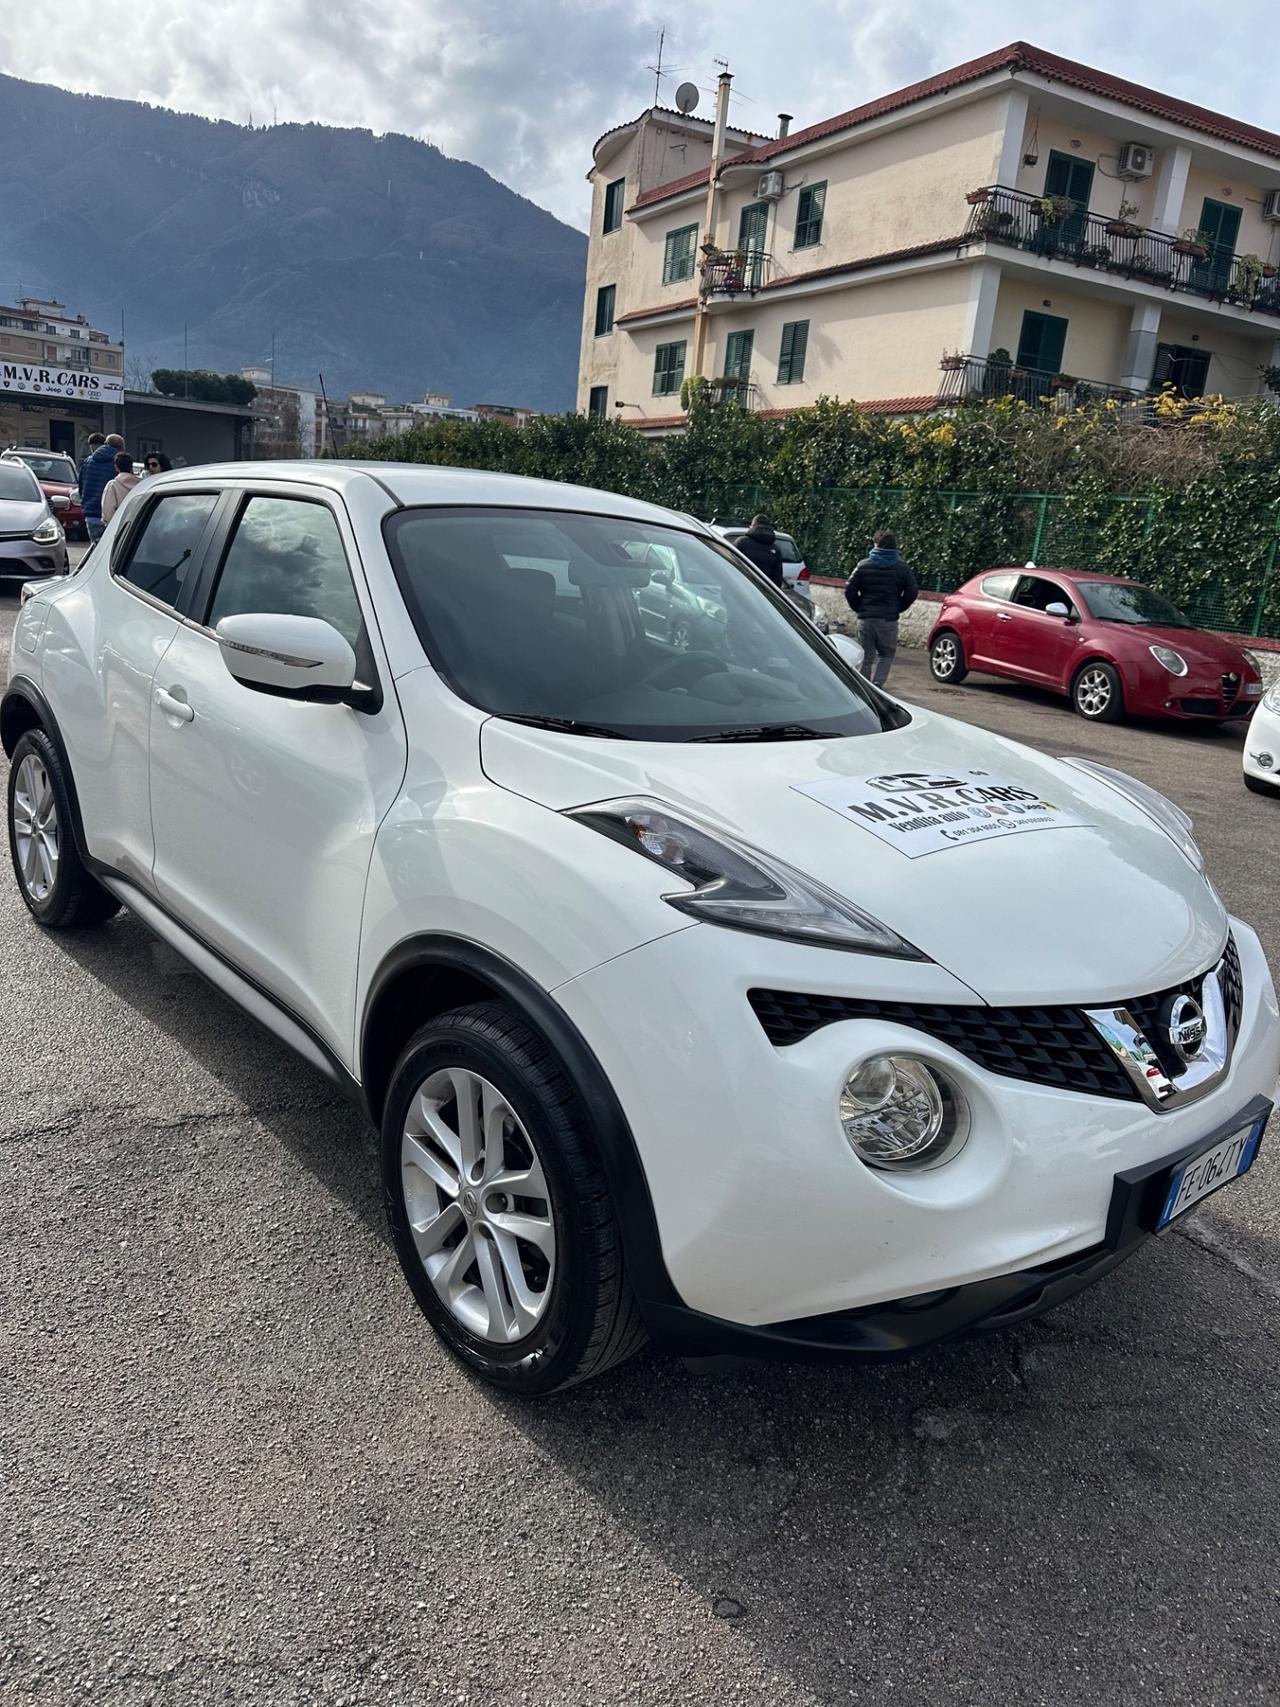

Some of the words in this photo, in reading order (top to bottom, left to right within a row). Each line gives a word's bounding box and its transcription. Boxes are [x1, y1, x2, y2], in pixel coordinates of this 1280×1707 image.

[46, 386, 61, 394] Jeep
[889, 813, 942, 833] Vendita
[941, 810, 970, 824] auto
